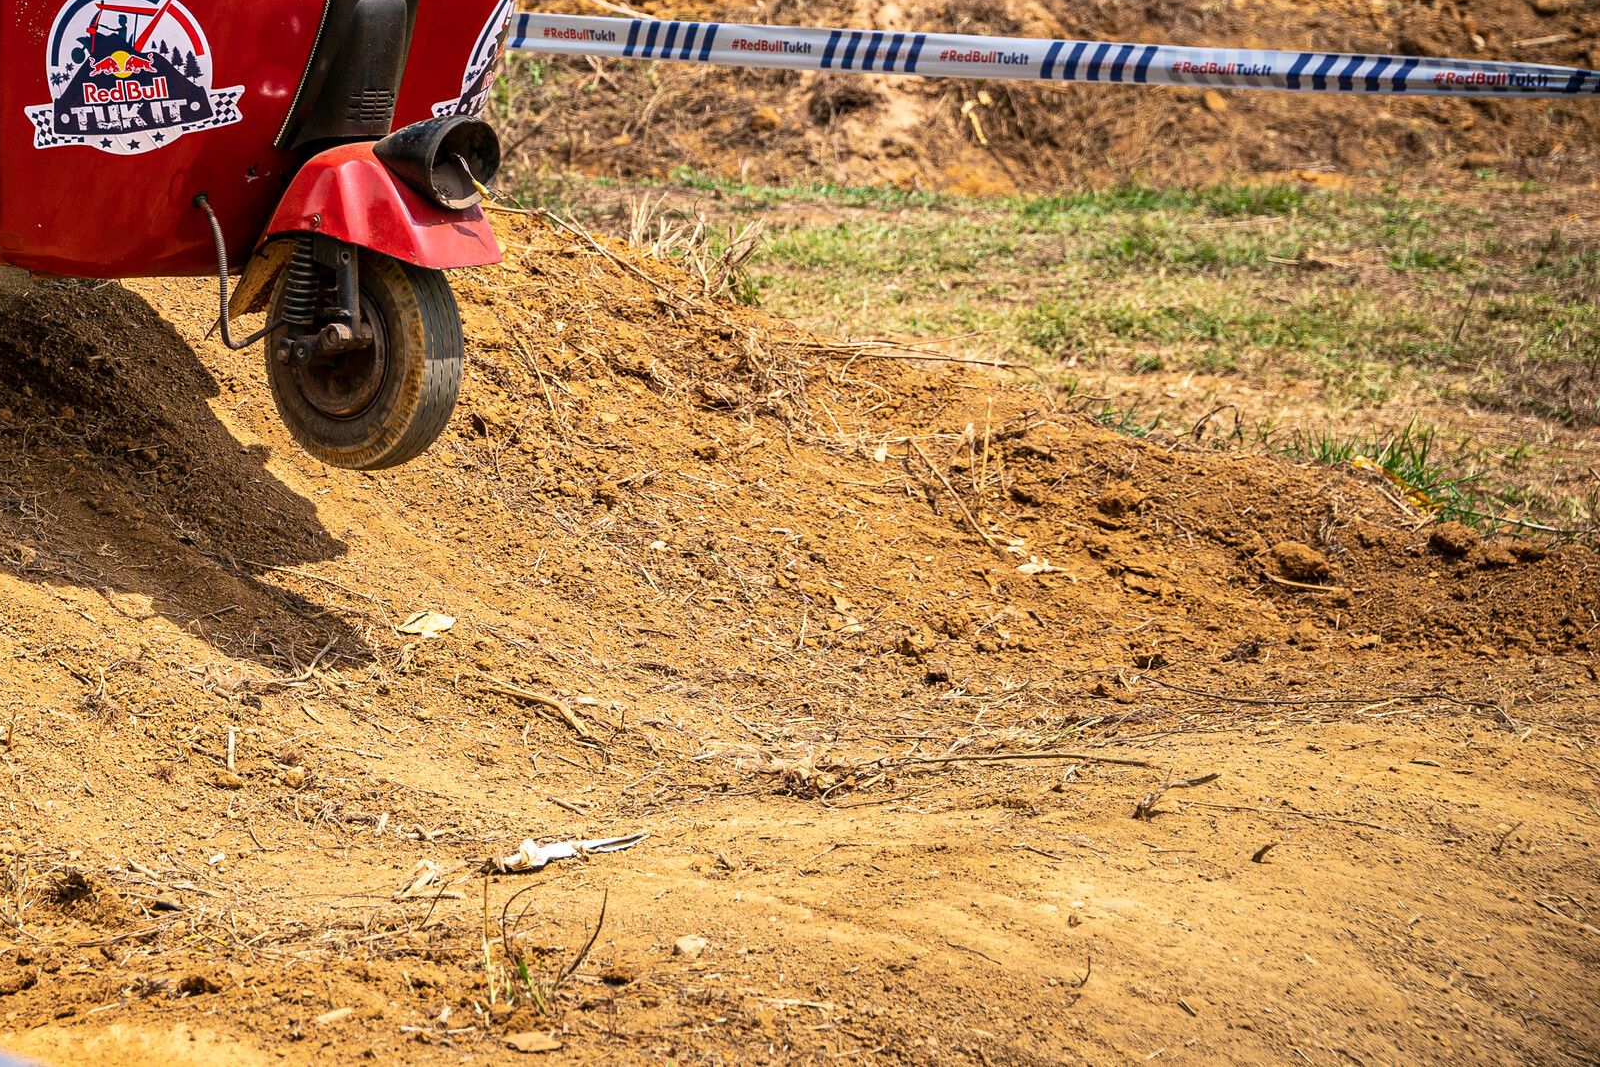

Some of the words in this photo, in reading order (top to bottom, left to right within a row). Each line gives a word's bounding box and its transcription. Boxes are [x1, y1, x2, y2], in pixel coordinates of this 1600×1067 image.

[543, 27, 616, 42] #RedBullTukIt
[731, 38, 812, 54] #RedBullTukIt
[939, 49, 1029, 65] #RedBullTukIt
[1171, 61, 1272, 77] #RedBullTukIt
[1434, 71, 1549, 87] #RedBullTukIt
[84, 80, 124, 104] Red
[126, 77, 168, 100] Bull
[71, 103, 151, 131] TUK
[151, 99, 187, 125] IT
